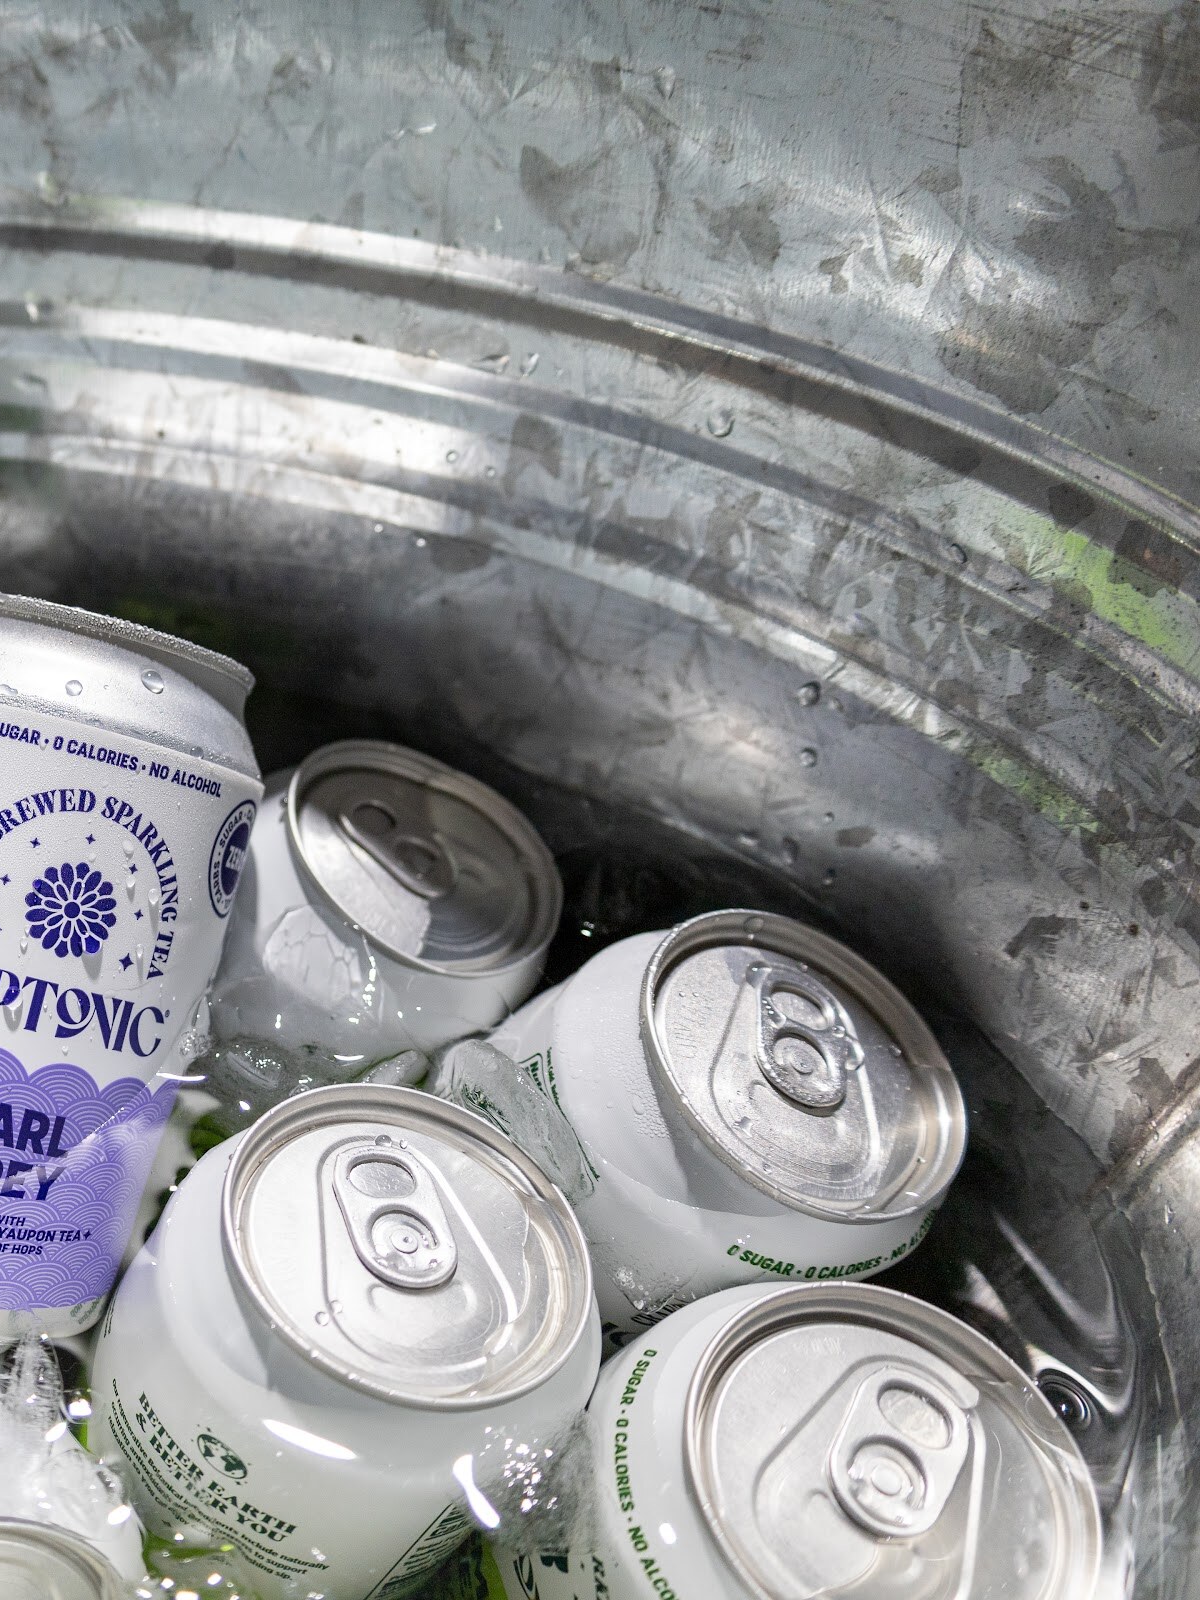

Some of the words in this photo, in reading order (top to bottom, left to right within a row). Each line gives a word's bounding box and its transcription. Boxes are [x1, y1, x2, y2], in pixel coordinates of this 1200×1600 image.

[52, 735, 64, 751] 0
[67, 740, 139, 772] CALORIES
[149, 762, 170, 781] NO
[171, 769, 222, 798] ALCOHOL
[101, 796, 180, 924] SPARKLING
[146, 929, 177, 981] TEA
[10, 1243, 44, 1256] HOPS
[58, 1228, 82, 1243] TEA
[726, 1243, 740, 1257] 0
[739, 1249, 795, 1277] SUGAR
[804, 1266, 816, 1279] 0
[817, 1255, 883, 1280] CALORIES
[890, 1242, 907, 1261] NO
[642, 1349, 658, 1358] 0
[619, 1359, 650, 1406] SUGAR
[107, 1415, 133, 1462] relaxation
[616, 1418, 629, 1428] 0
[111, 1378, 119, 1398] Our
[117, 1398, 149, 1460] regenerative
[240, 1533, 279, 1557] include
[279, 1553, 330, 1571] naturally
[135, 1411, 148, 1434] &
[236, 1511, 288, 1543] YOU
[138, 1391, 205, 1479] BETTER
[208, 1480, 299, 1535] EARTH
[614, 1432, 635, 1513] CALORIES
[628, 1525, 649, 1553] NO
[265, 1557, 308, 1576] support
[640, 1557, 681, 1600] ALCO
